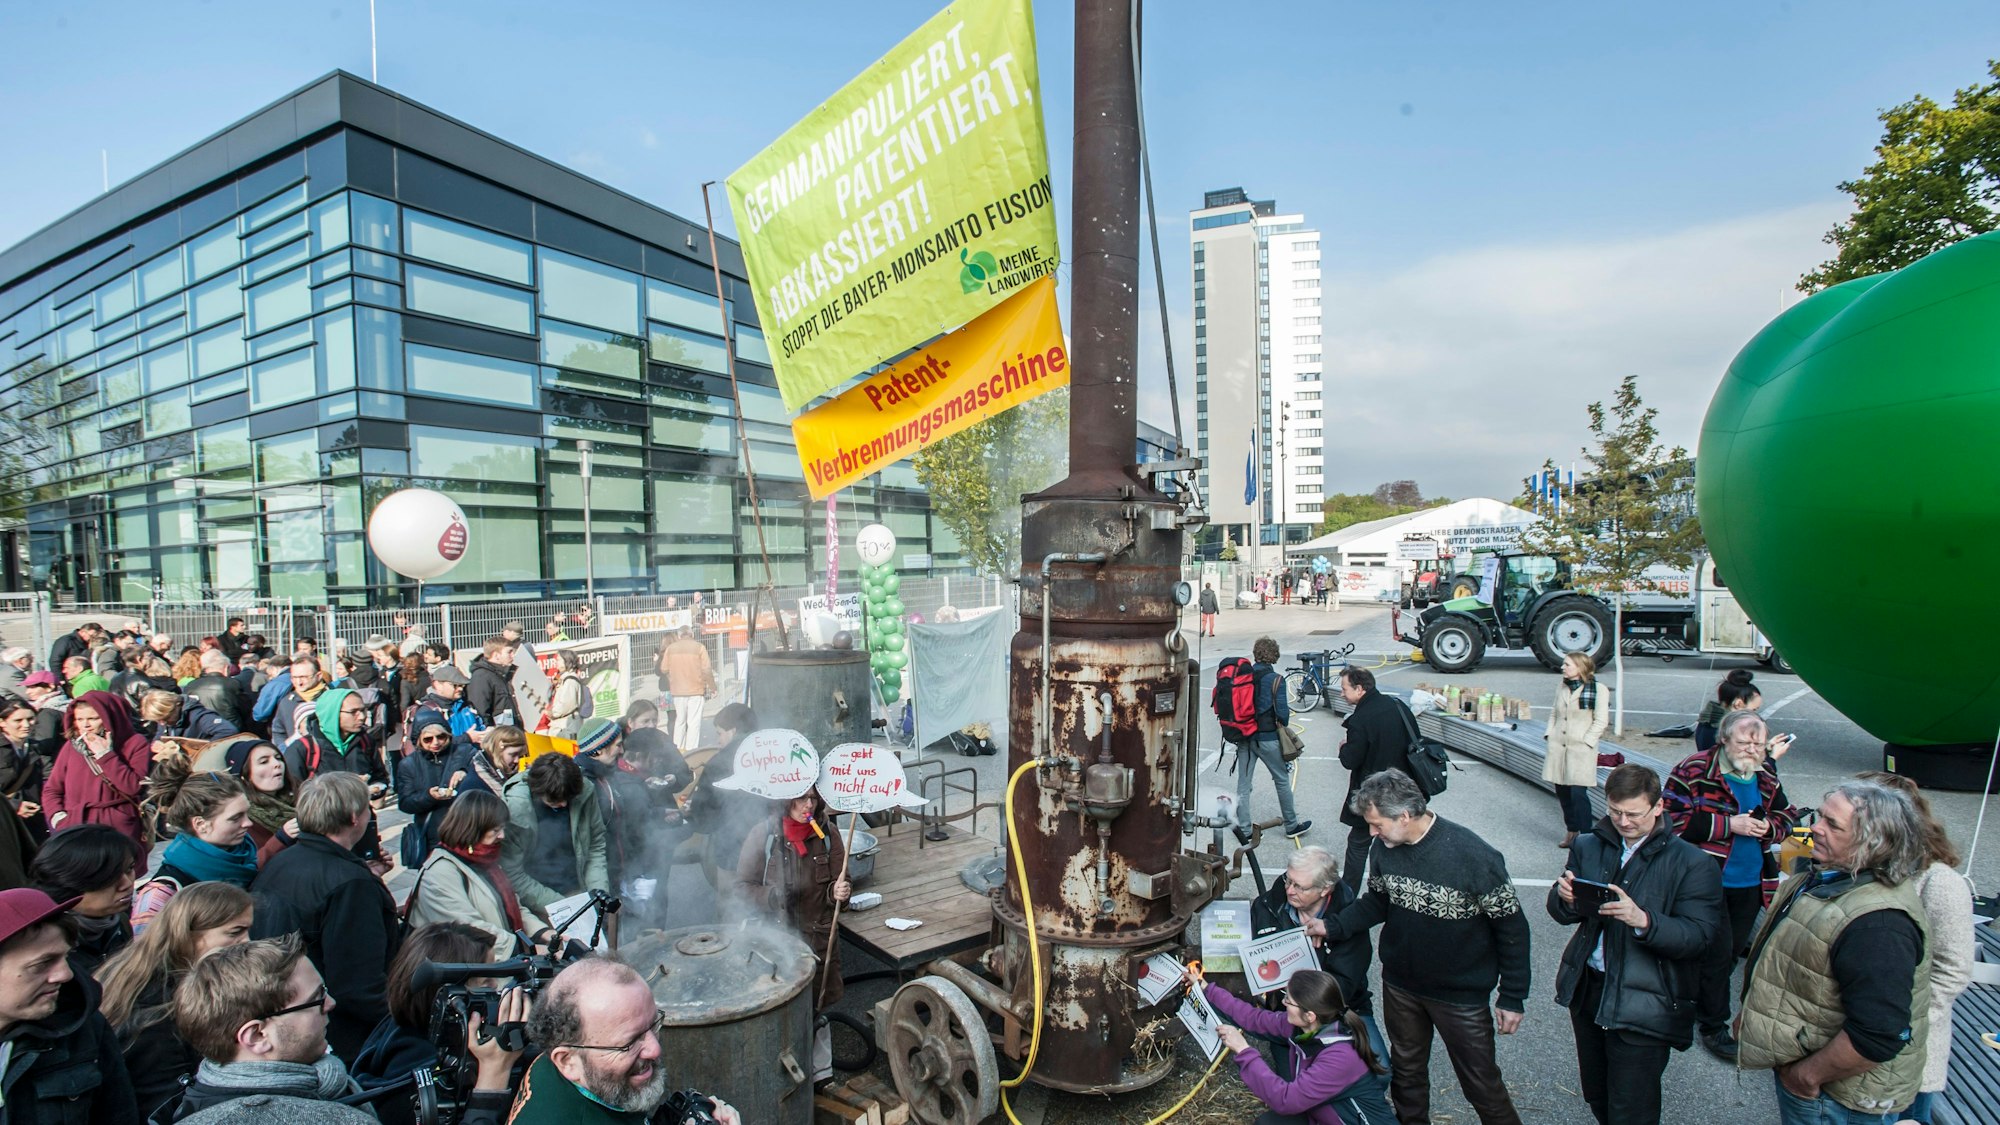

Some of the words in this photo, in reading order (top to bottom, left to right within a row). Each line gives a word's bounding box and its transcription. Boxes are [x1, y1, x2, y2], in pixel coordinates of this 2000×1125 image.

[744, 20, 979, 234] GENMANIPULIERT,
[835, 51, 1034, 219] PATENTIERT,
[768, 178, 932, 329] ABKASSIERT!
[999, 245, 1041, 274] MEINE
[781, 313, 820, 360] STOPPT
[821, 299, 843, 330] DIE
[843, 211, 983, 315] BAYER-MONSANTO
[983, 173, 1054, 231] FUSION
[864, 353, 951, 412] Patent-
[808, 346, 1066, 487] Verbrennungsmaschine
[1430, 528, 1452, 536] LIEBE
[613, 613, 667, 631] INKOTA
[705, 607, 732, 625] BROT
[578, 648, 619, 665] TOPPEN!
[755, 737, 779, 748] Eure
[740, 750, 785, 774] Glypho
[829, 764, 852, 776] mit
[857, 767, 877, 776] uns
[834, 778, 865, 794] nicht
[1249, 944, 1274, 957] PATENT
